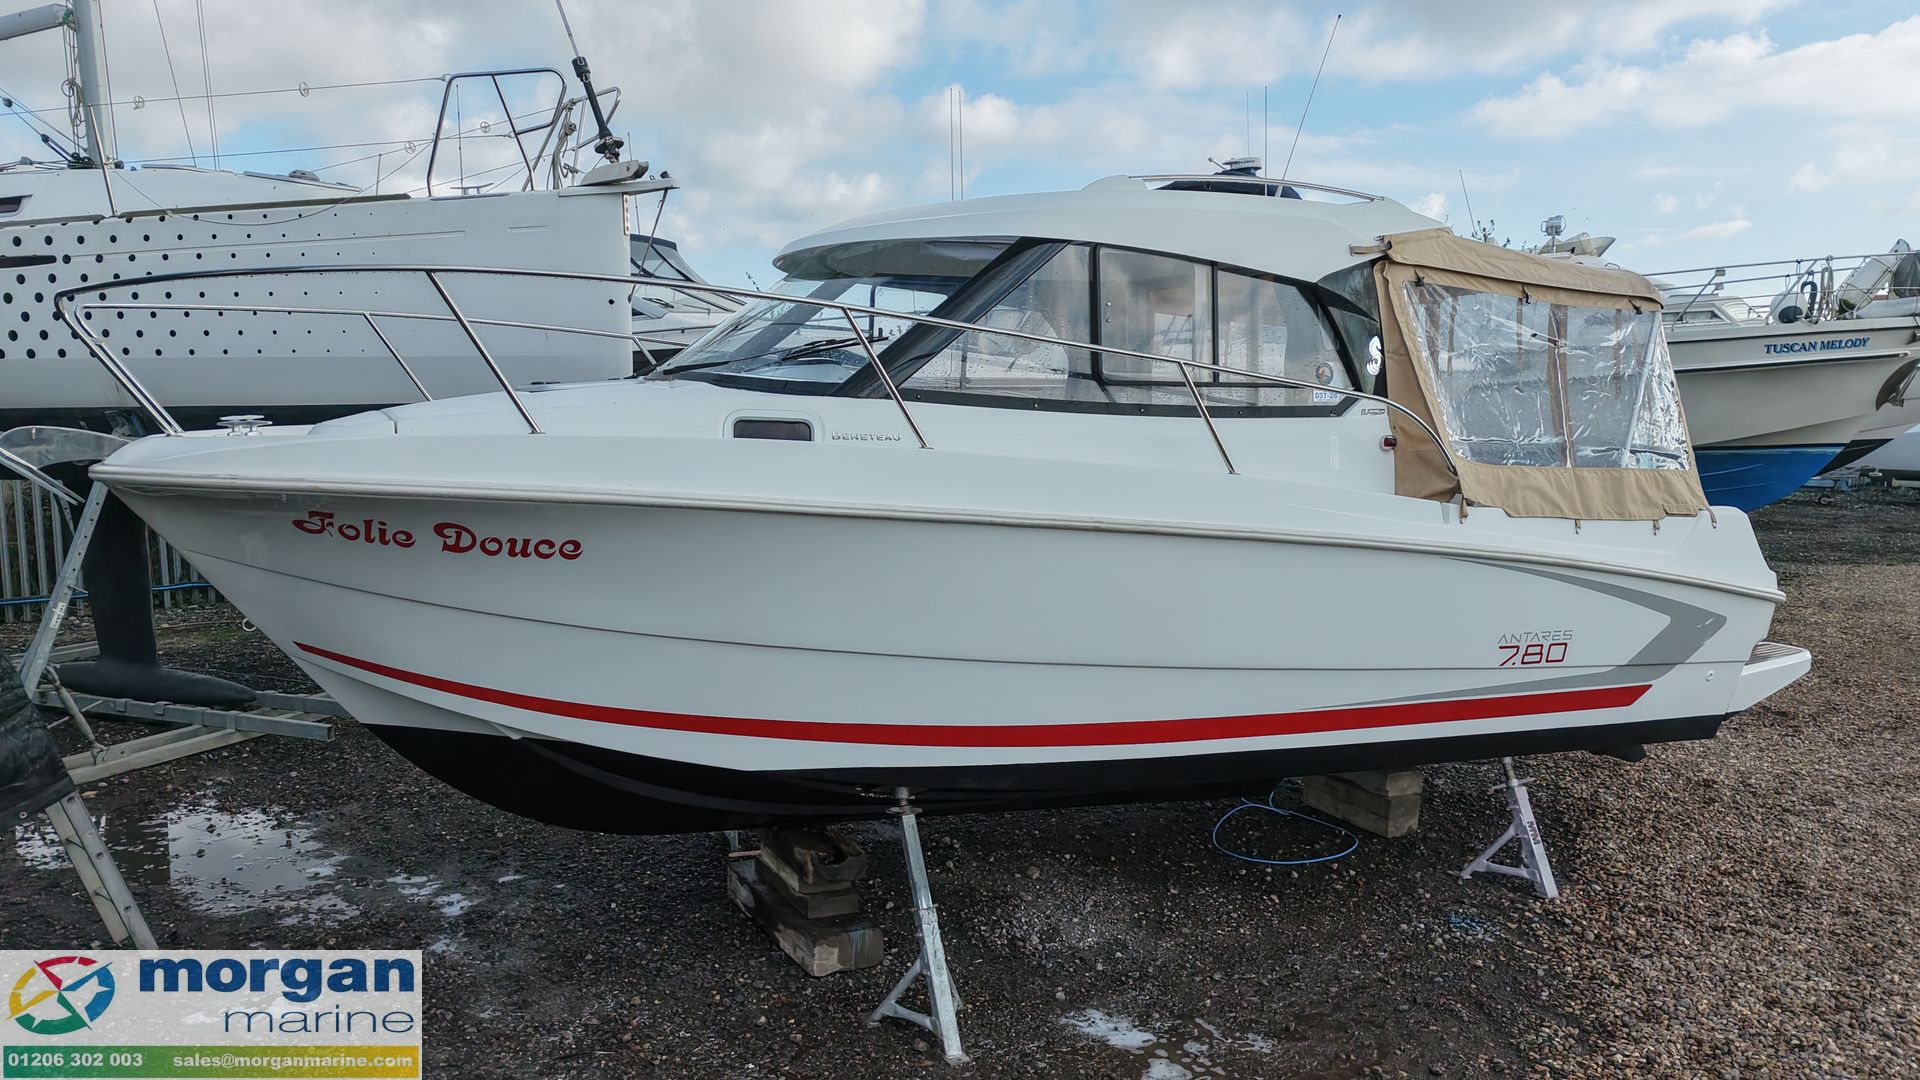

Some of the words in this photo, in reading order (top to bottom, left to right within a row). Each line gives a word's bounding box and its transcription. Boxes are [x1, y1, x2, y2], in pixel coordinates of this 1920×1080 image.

[1764, 342, 1818, 354] TUSCAN
[1820, 337, 1870, 350] MELODY
[831, 431, 902, 442] BENETEAU
[291, 510, 416, 548] Folie
[432, 522, 583, 560] Douce
[1497, 630, 1574, 644] ANTARES
[1499, 642, 1567, 666] 7.80
